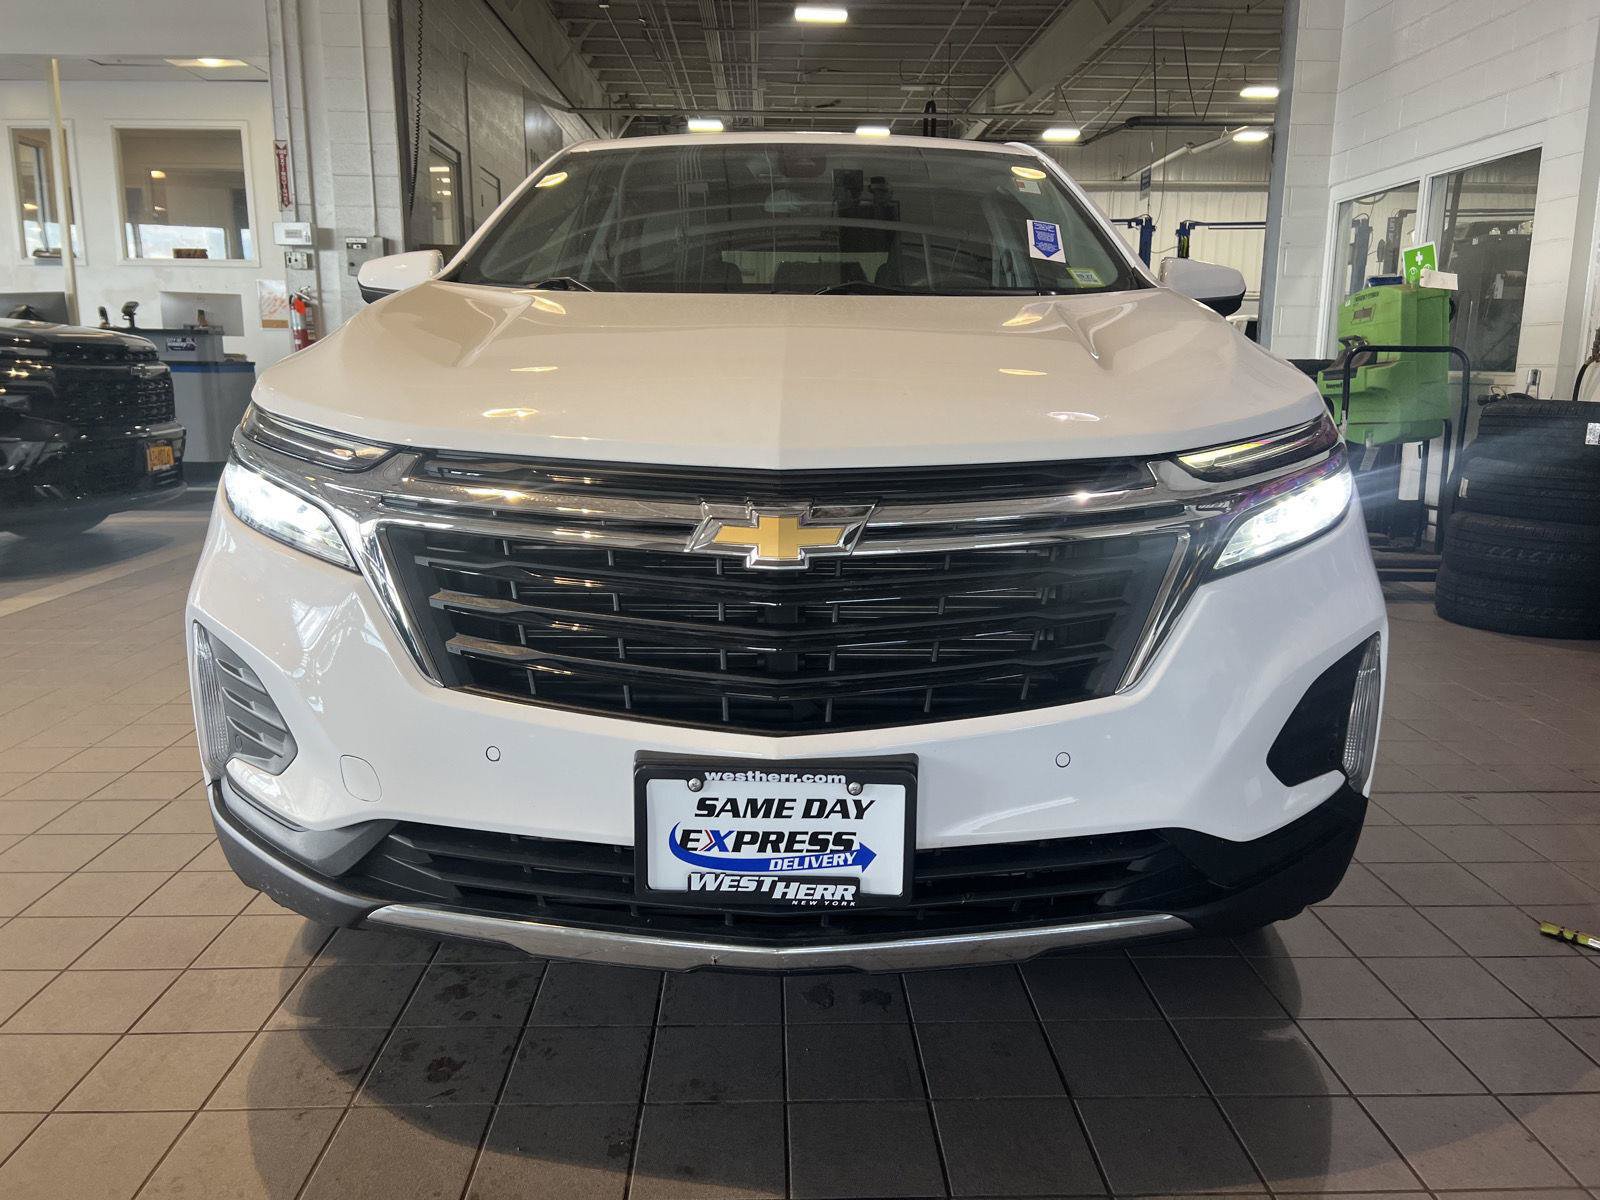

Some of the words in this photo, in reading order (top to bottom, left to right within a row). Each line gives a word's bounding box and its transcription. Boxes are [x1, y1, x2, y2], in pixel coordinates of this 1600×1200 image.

[704, 771, 846, 784] westherr.com
[694, 797, 797, 819] SAME
[801, 798, 877, 820] DAY
[679, 829, 857, 853] EXPRESS
[769, 852, 857, 871] DELIVERY
